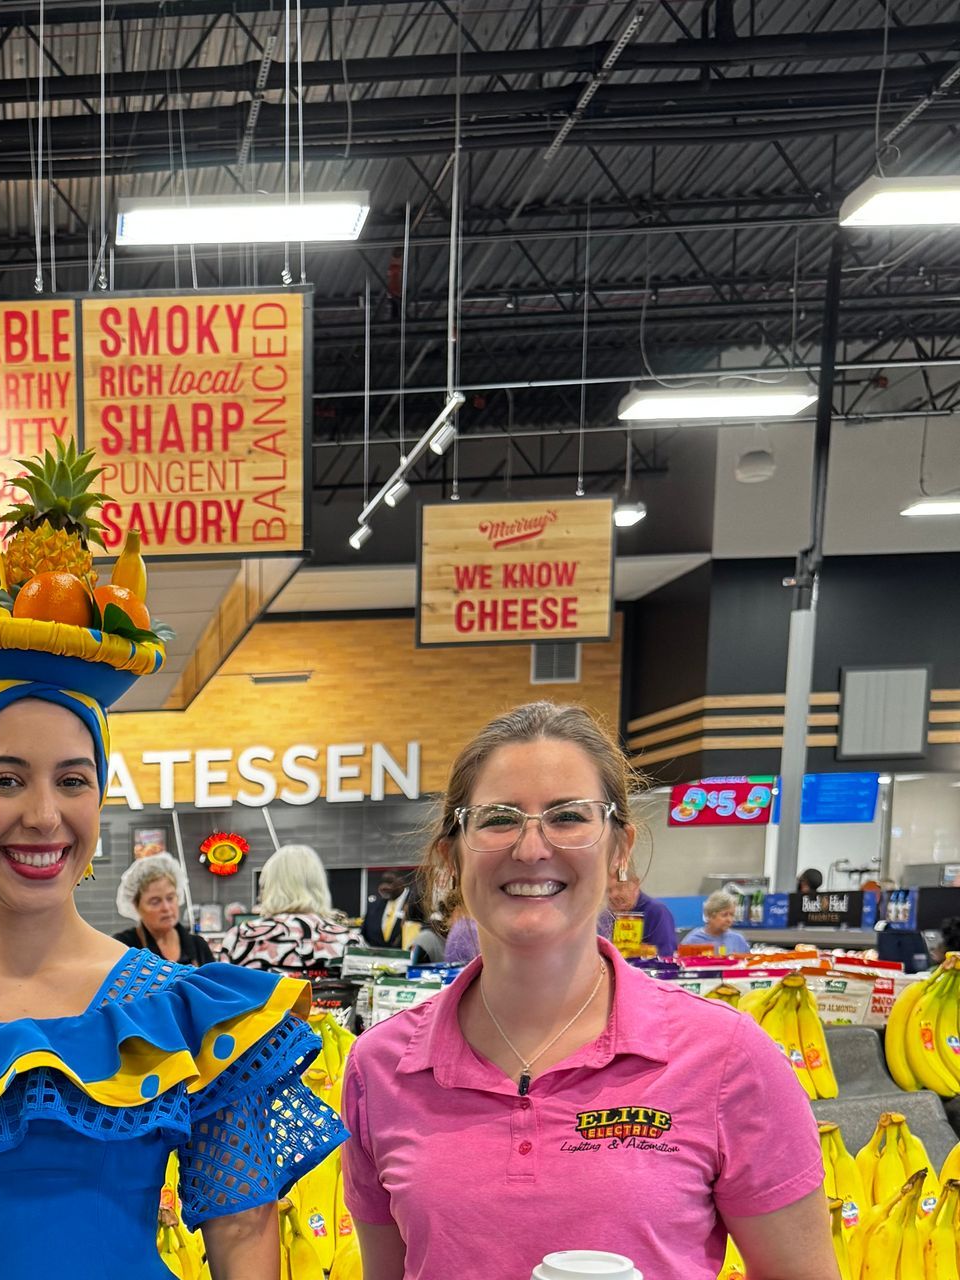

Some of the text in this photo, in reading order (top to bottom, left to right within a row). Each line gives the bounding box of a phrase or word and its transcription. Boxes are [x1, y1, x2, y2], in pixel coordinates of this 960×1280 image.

[100, 303, 246, 358] SMOKY
[100, 361, 246, 398] RICH local
[101, 401, 245, 456] SHARP
[252, 301, 288, 543] BALANCED
[101, 459, 246, 495] PUNGENT
[101, 498, 246, 549] SAVORY
[454, 560, 578, 592] WE KNOW
[455, 596, 578, 634] CHEESE
[577, 1107, 671, 1129] ELITE
[588, 1124, 658, 1138] ELECTRIC
[560, 1137, 680, 1153] Lighting & Automation
